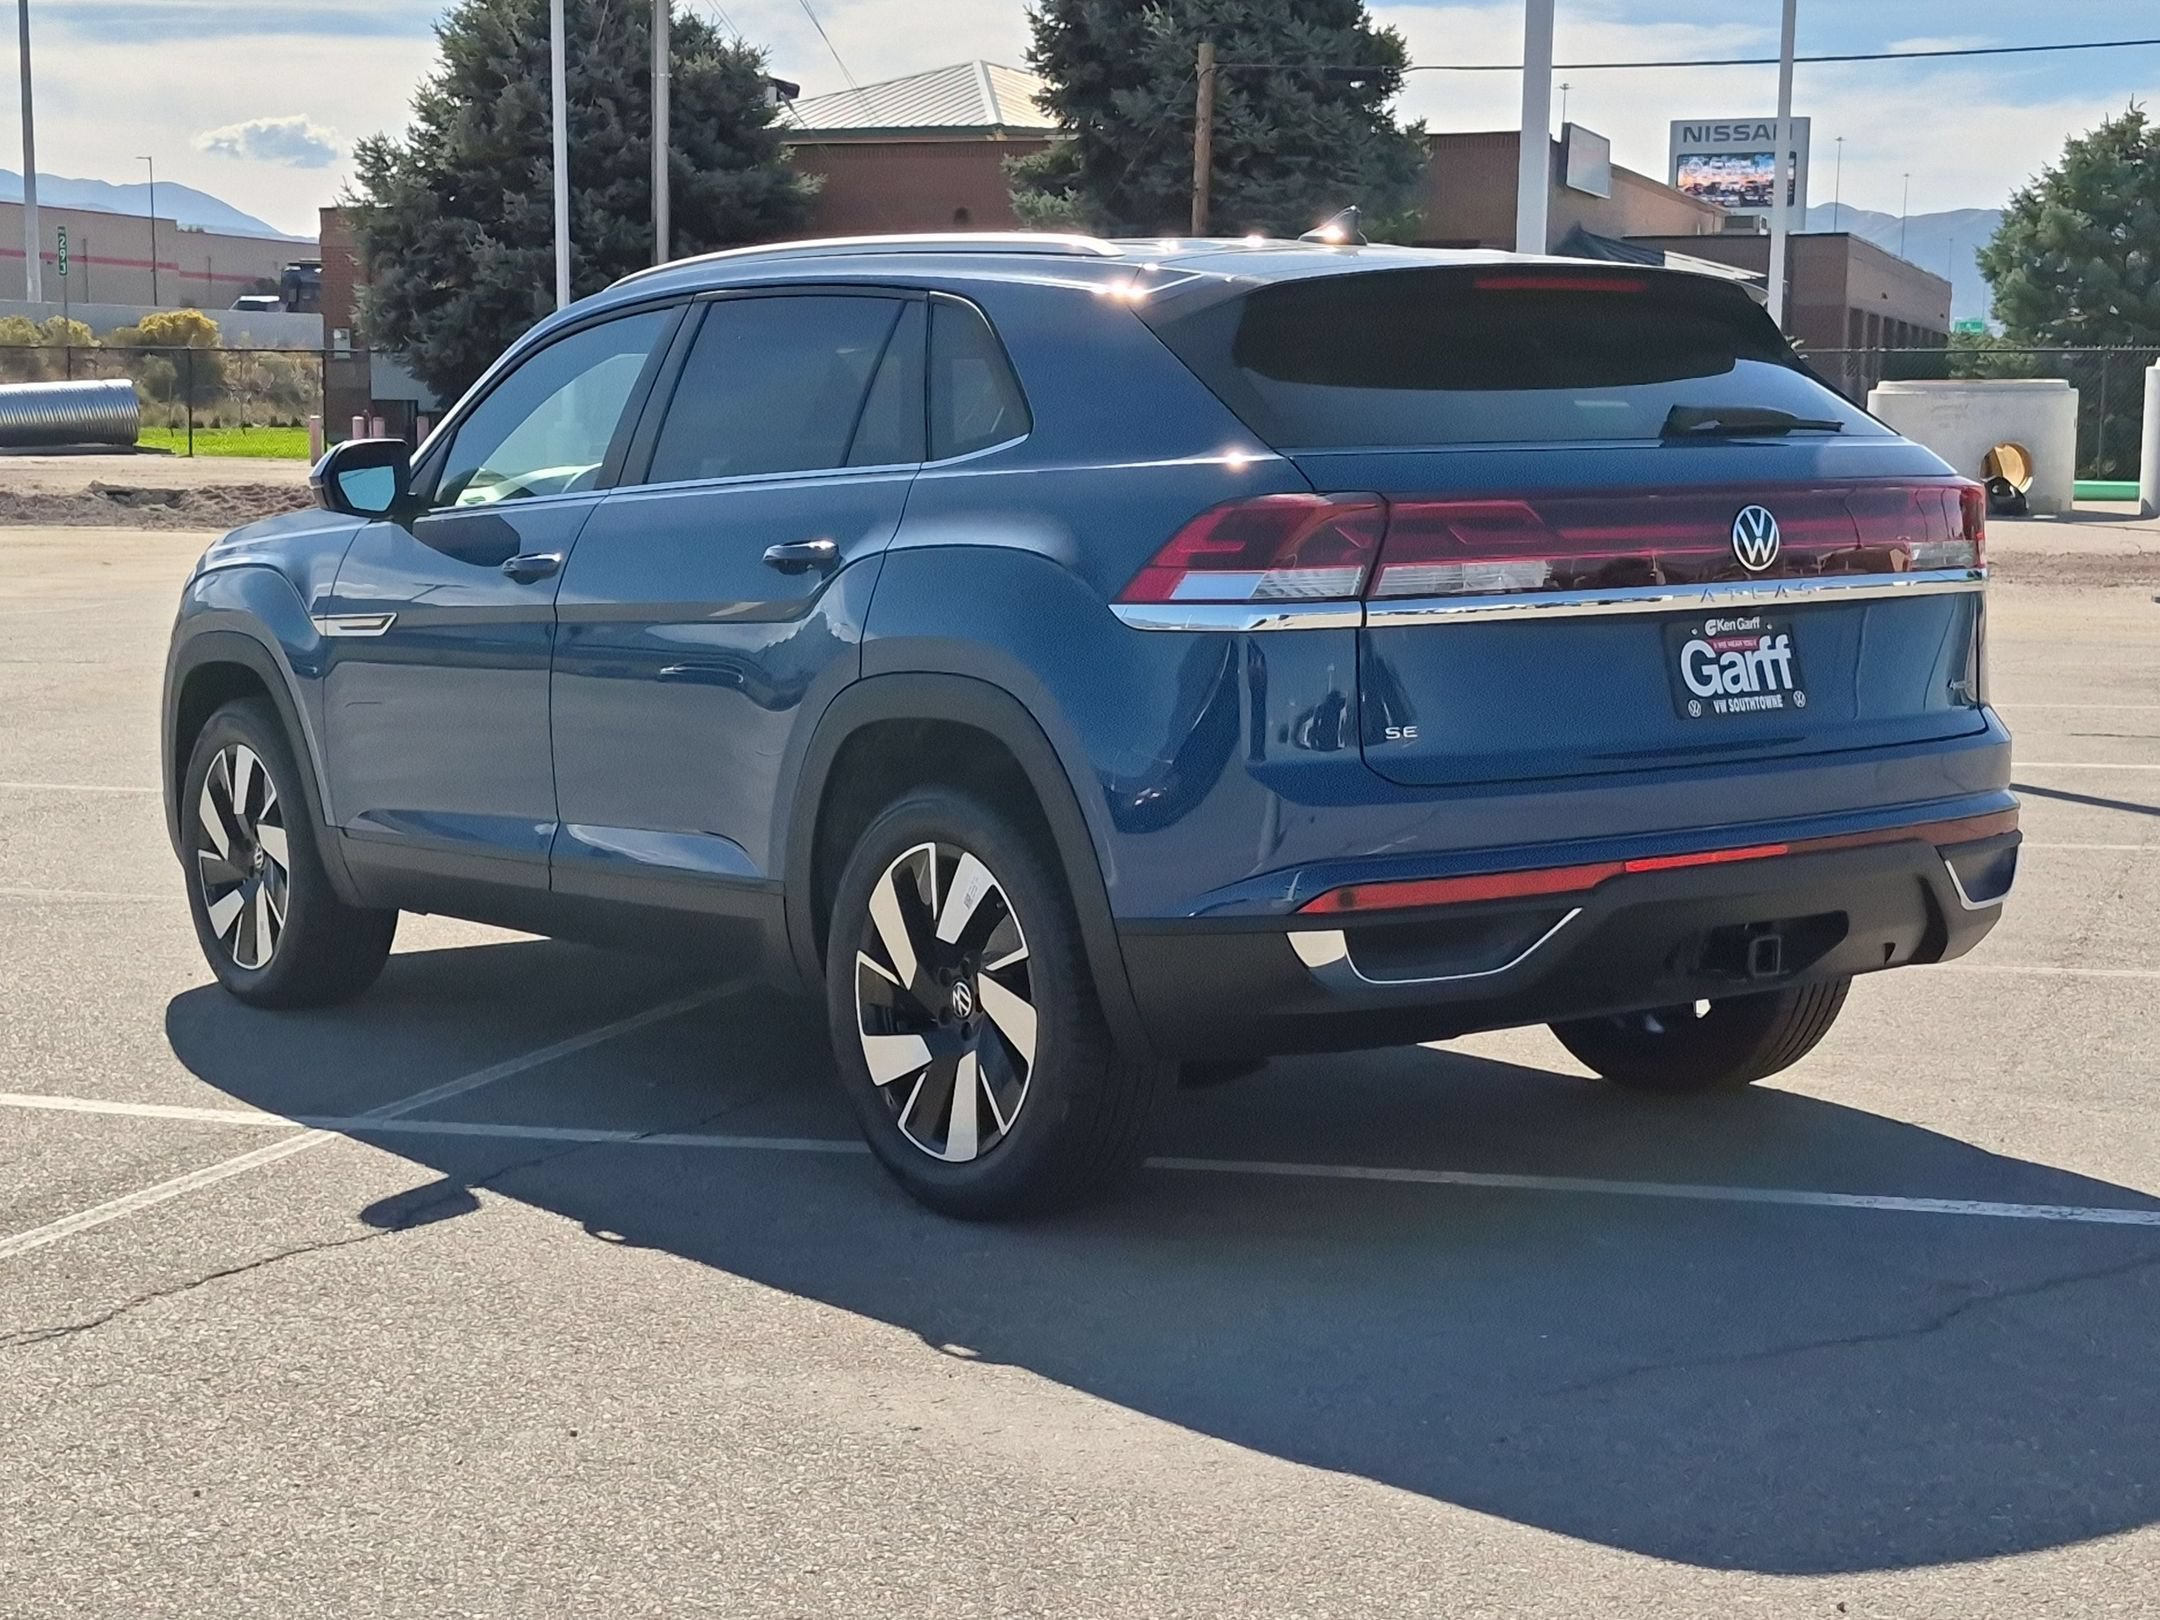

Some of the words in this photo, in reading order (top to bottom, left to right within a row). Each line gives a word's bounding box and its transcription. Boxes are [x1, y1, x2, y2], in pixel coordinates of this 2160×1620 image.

[1700, 582, 1813, 603] ATLAS
[1717, 618, 1736, 631] Ken
[1736, 616, 1760, 630] Garff
[1680, 634, 1793, 697] Garff
[1713, 699, 1727, 714] VW
[1728, 694, 1783, 712] SOUTHTOWNE
[1385, 726, 1418, 739] SE
